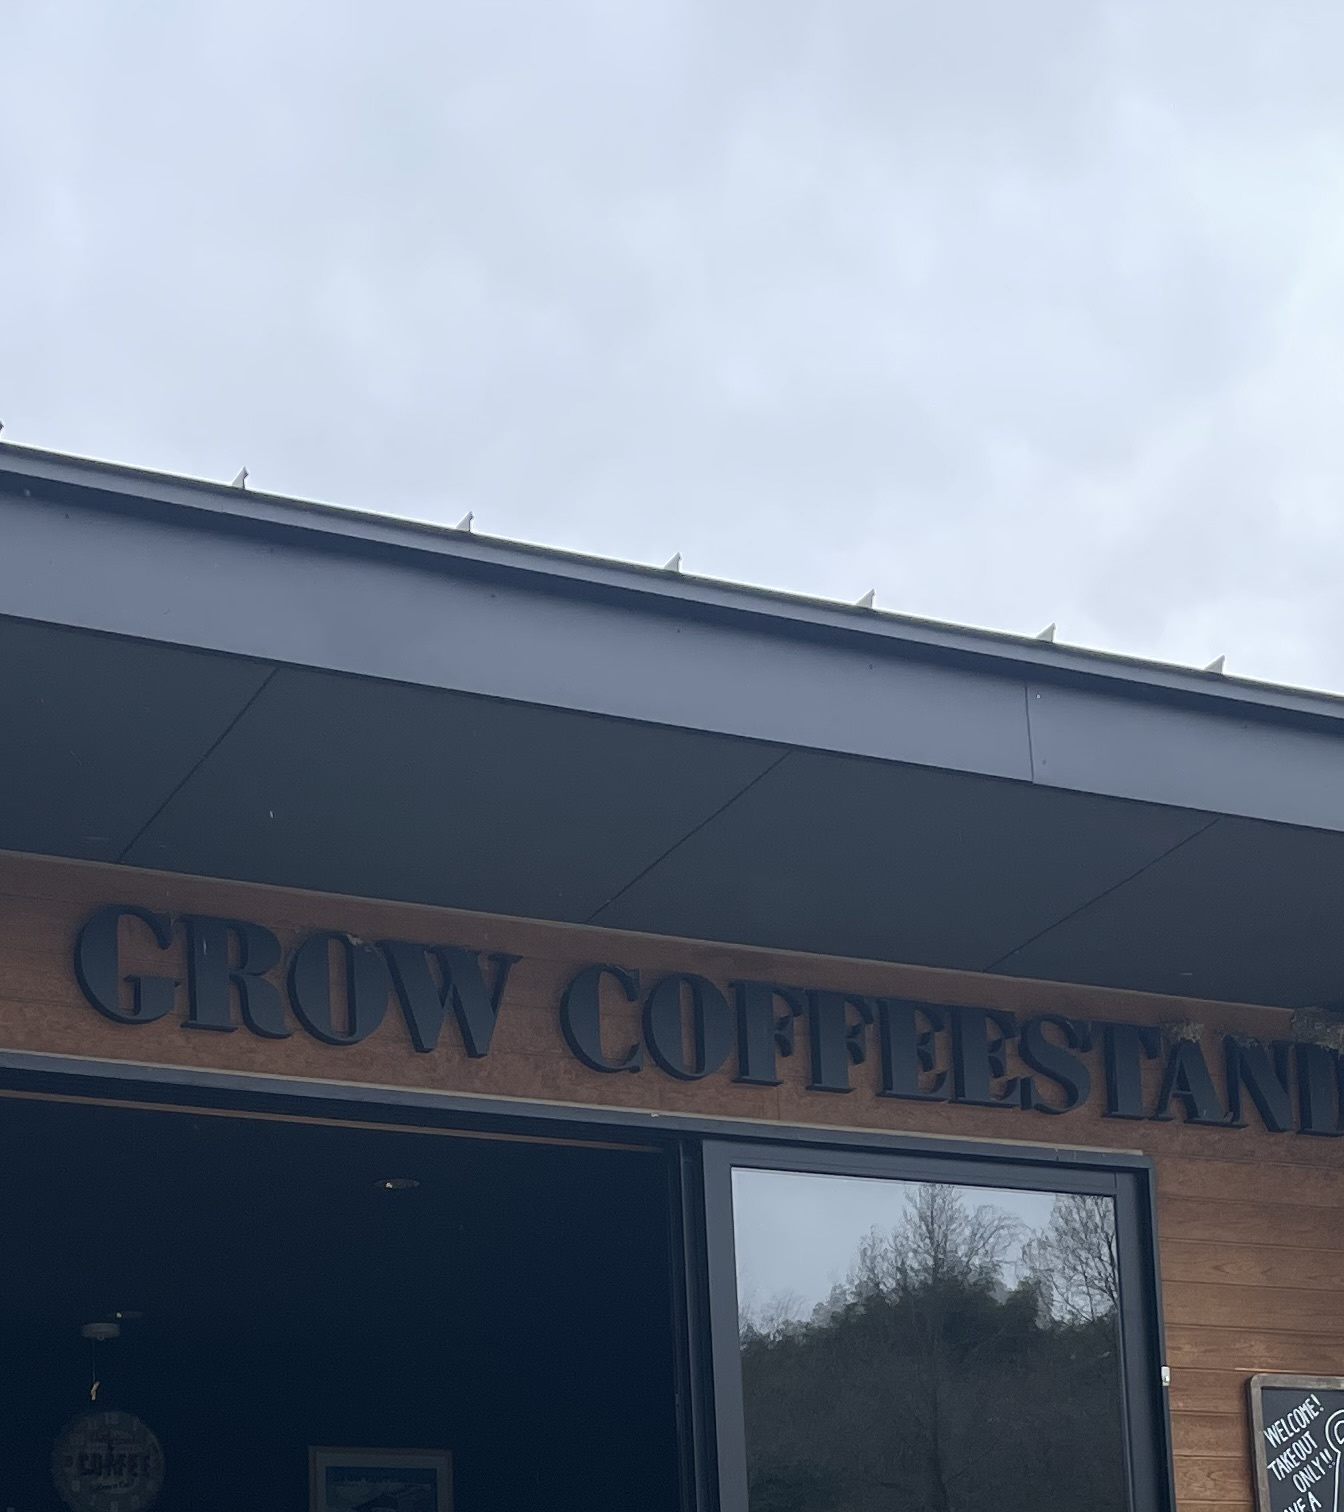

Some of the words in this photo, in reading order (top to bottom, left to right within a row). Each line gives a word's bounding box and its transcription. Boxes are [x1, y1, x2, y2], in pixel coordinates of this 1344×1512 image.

[74, 904, 523, 1059] GROW
[1263, 1393, 1324, 1448] WELCOME!
[1267, 1430, 1318, 1481] TAKEOUT
[1307, 1491, 1322, 1512] A
